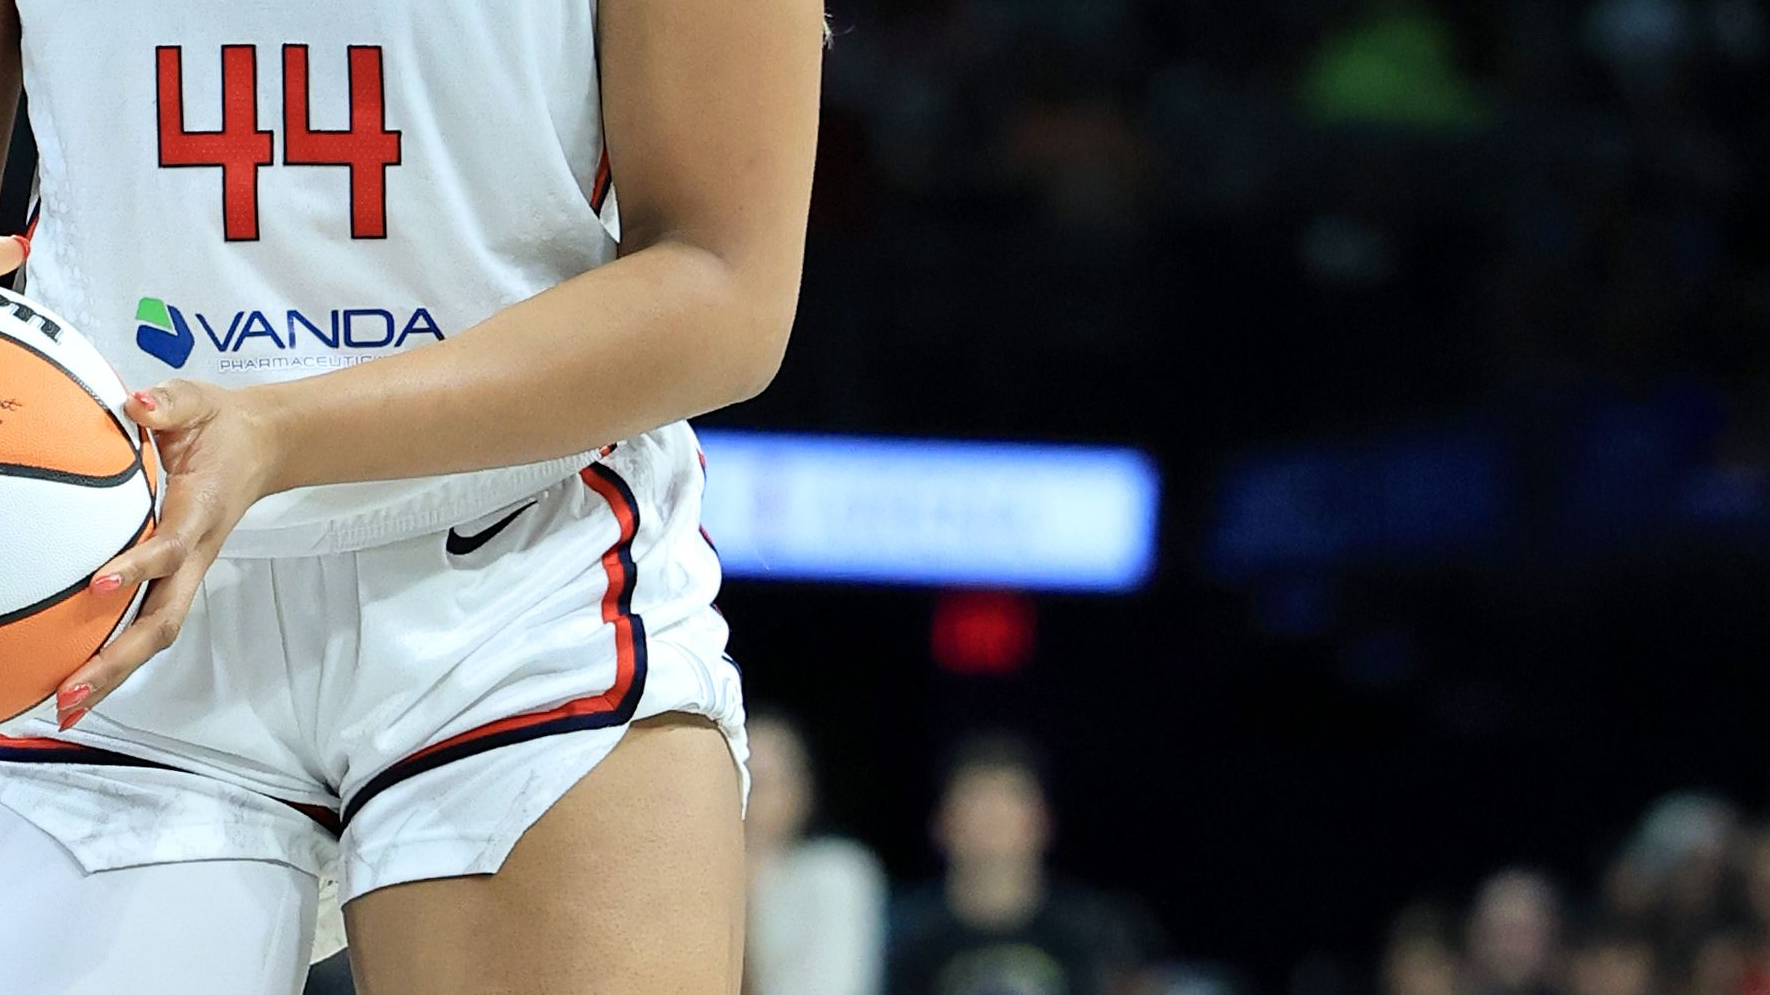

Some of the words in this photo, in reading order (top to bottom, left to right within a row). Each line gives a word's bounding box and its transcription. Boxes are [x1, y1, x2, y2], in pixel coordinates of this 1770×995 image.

[155, 43, 402, 242] 44
[195, 307, 445, 352] VANDA
[220, 355, 390, 370] PHARMACEUTIC
